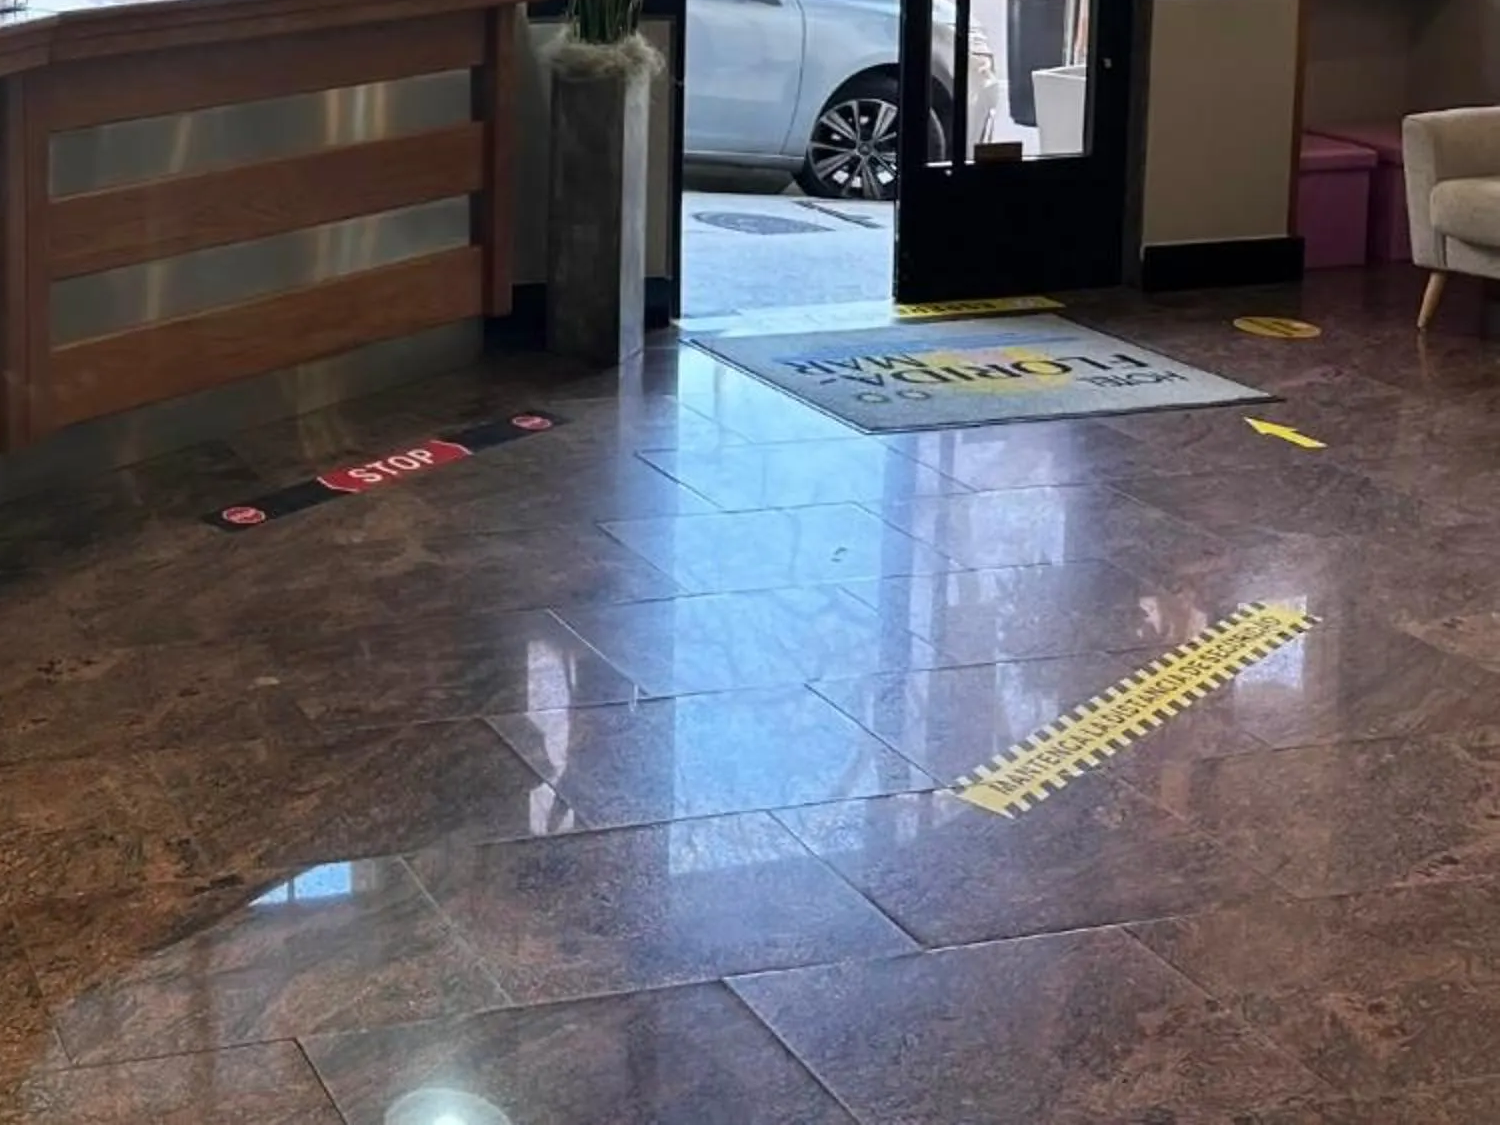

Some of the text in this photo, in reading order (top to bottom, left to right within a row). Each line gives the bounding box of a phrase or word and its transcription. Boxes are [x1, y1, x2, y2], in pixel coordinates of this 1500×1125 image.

[782, 353, 929, 374] MAR
[347, 448, 434, 483] STOP
[988, 734, 1097, 795] MANTENGA
